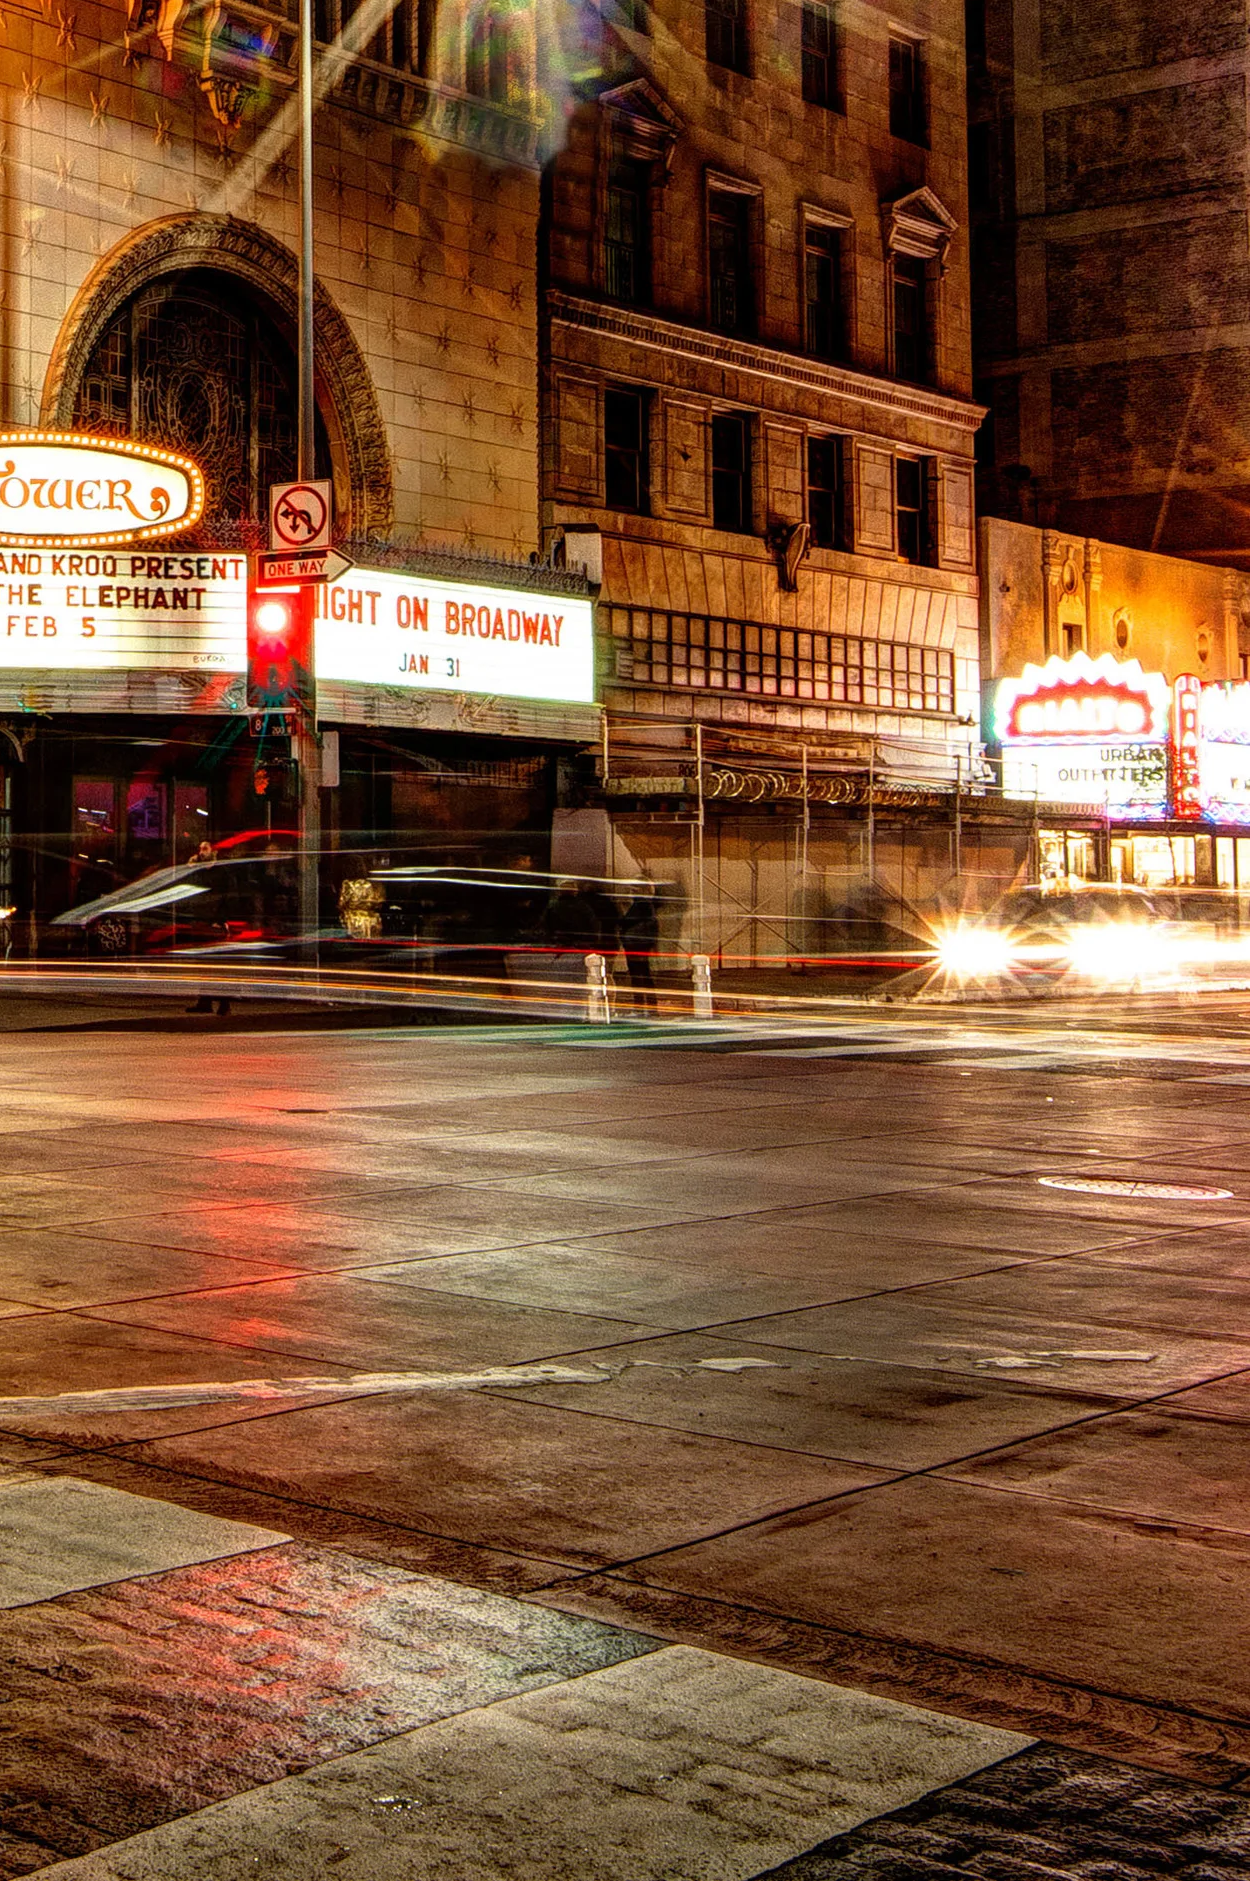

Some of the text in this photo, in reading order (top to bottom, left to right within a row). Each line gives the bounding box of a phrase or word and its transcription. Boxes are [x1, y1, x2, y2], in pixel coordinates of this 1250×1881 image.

[131, 556, 244, 581] PRESENT
[268, 560, 326, 576] ONE WAY
[66, 585, 207, 610] ELEPHANT
[7, 616, 96, 637] FEB 5
[397, 595, 429, 631] ON
[445, 601, 564, 647] BROADWAY
[399, 653, 460, 677] JAN 31
[1100, 748, 1163, 762] URBAN
